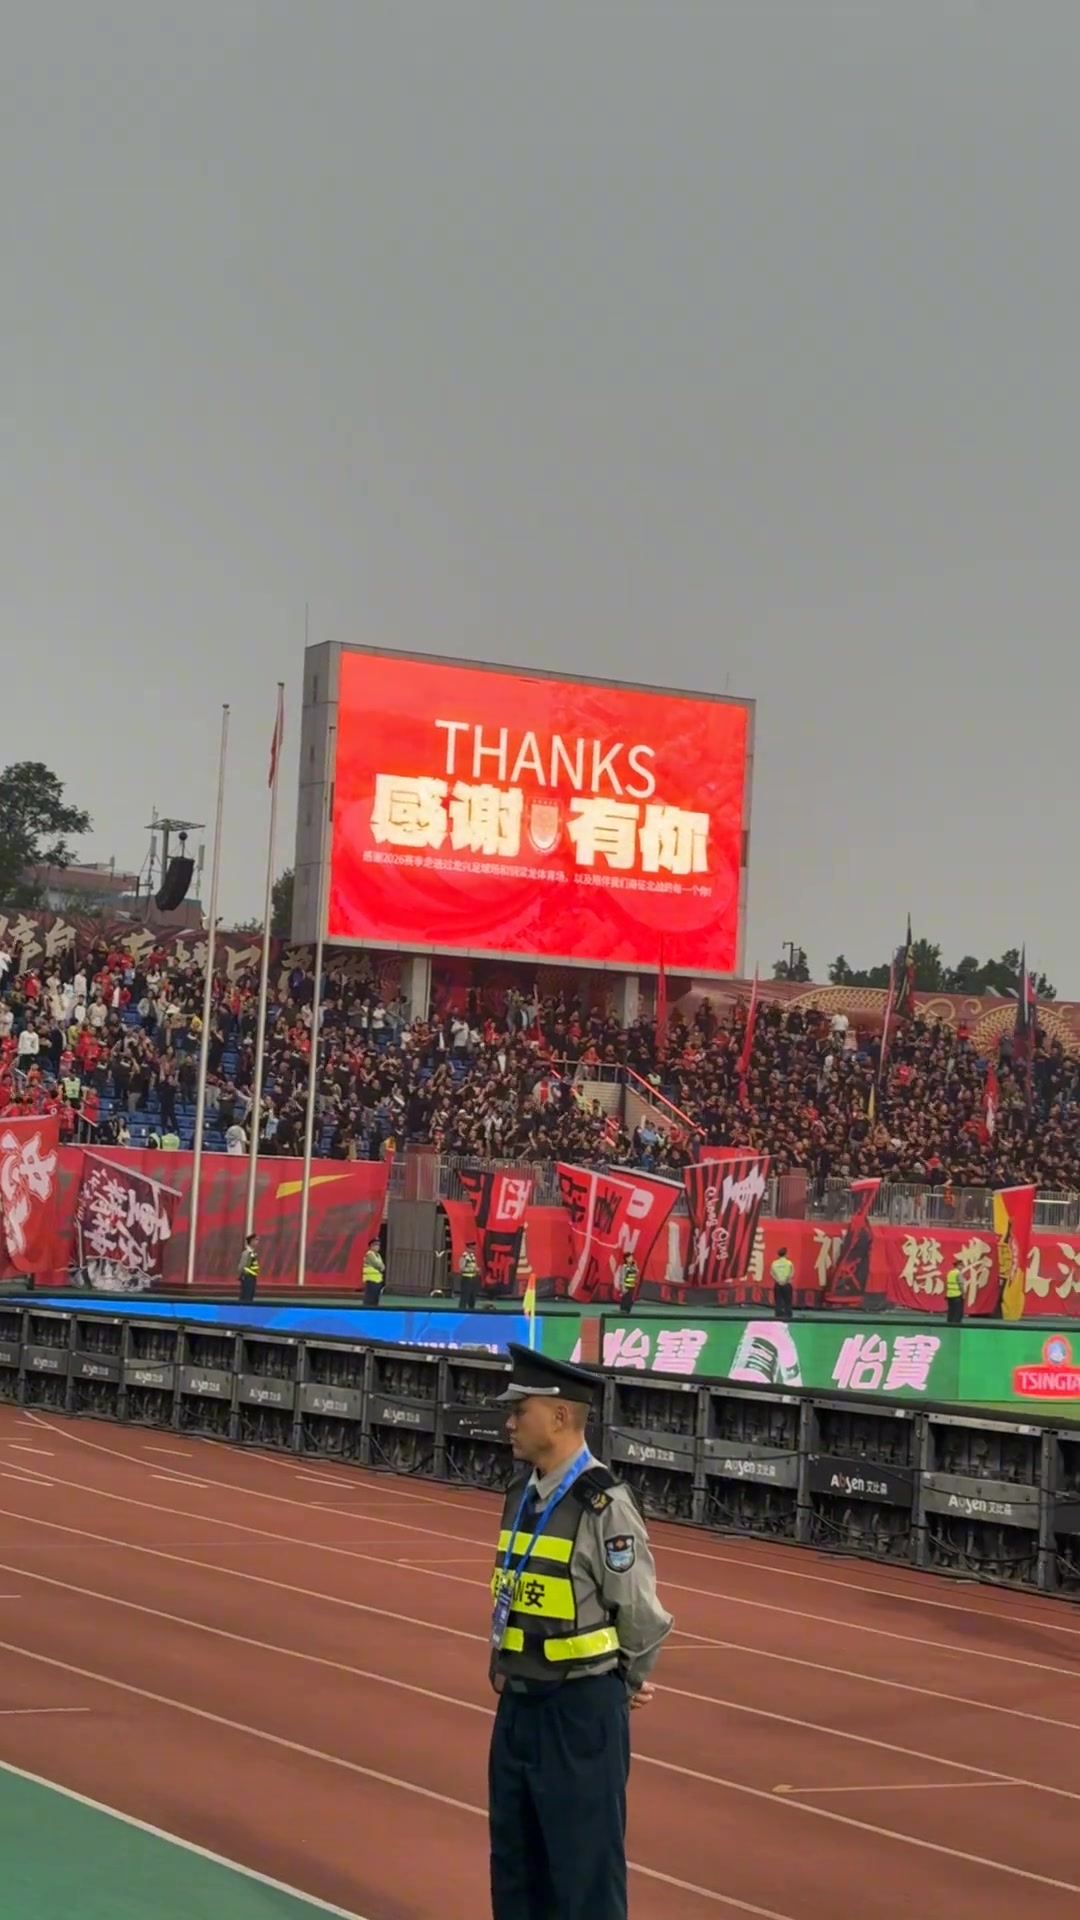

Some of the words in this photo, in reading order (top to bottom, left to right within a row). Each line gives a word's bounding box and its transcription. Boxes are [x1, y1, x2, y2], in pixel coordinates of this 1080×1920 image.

[435, 719, 656, 799] THANKS
[369, 773, 523, 857] 感谢
[566, 796, 710, 875] 有你
[831, 1333, 941, 1391] 怡寶
[830, 1472, 865, 1493] Absen
